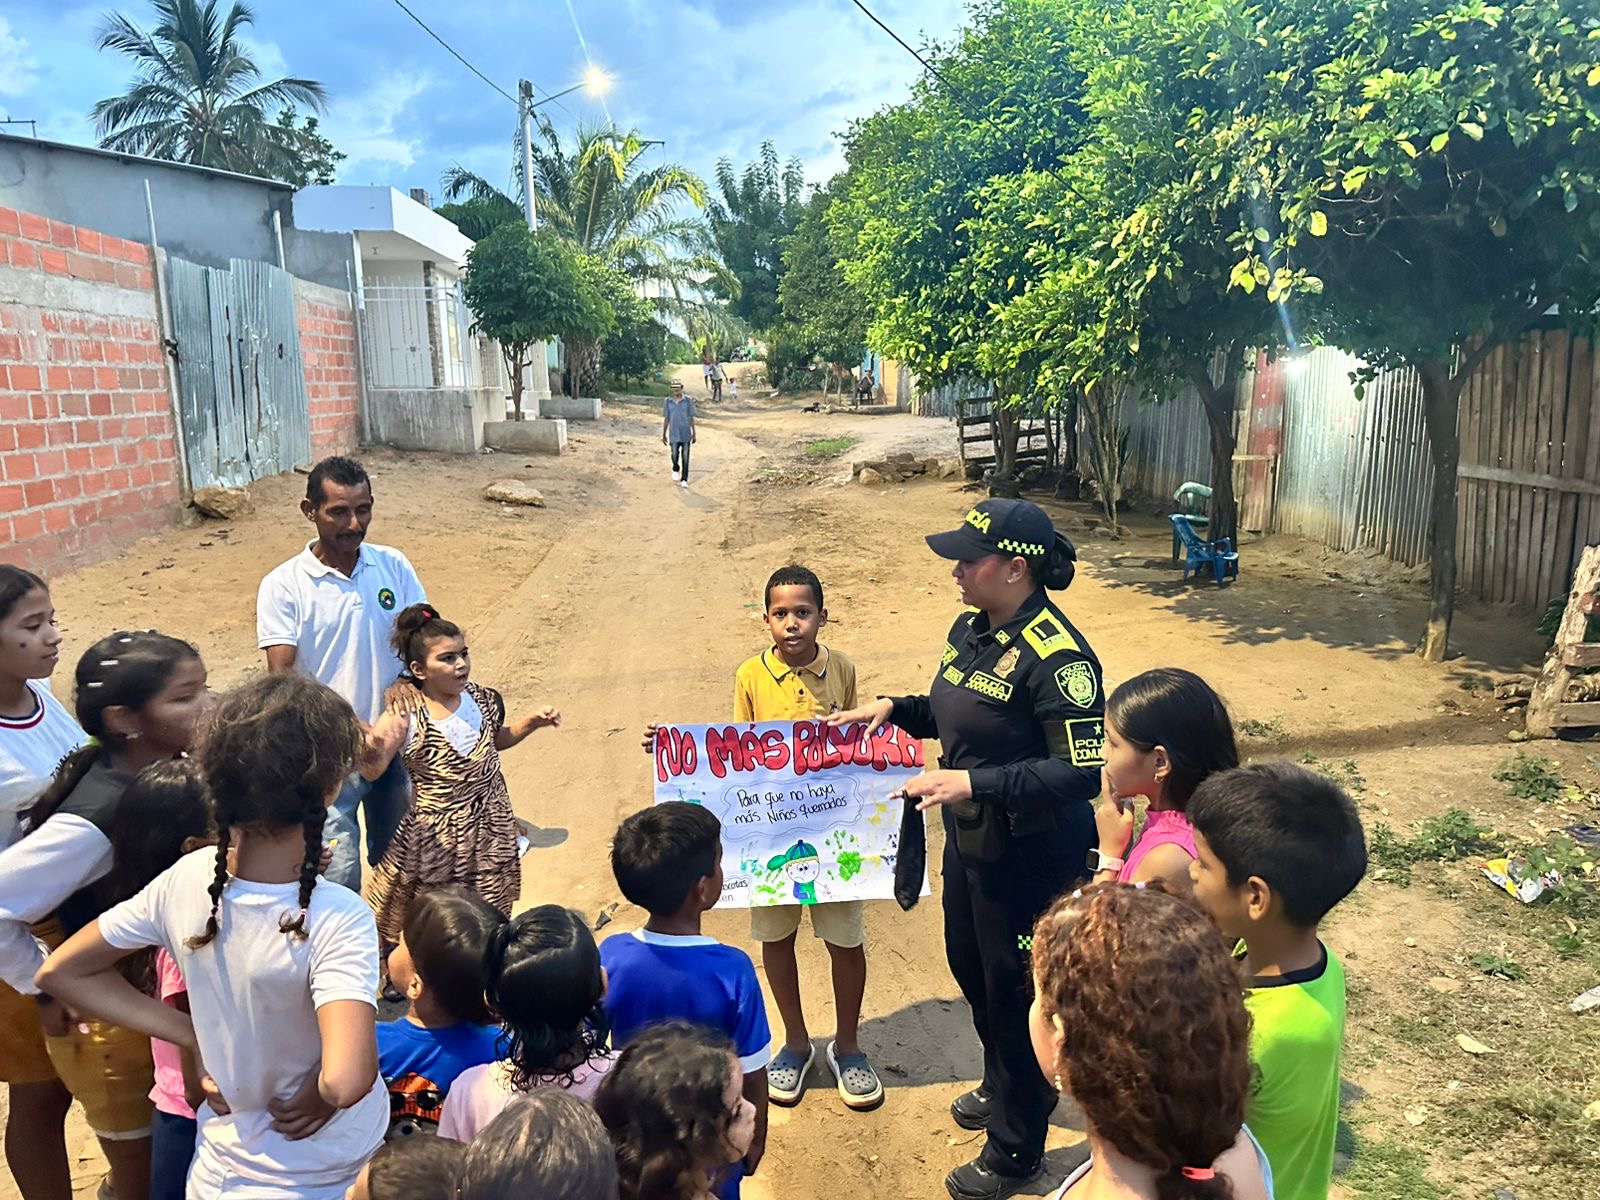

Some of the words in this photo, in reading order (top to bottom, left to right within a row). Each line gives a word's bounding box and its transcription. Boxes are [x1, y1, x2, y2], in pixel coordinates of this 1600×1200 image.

[656, 726, 698, 782] NO
[706, 723, 790, 778] MÁS
[735, 810, 760, 823] más
[767, 809, 797, 824] Niños
[800, 796, 847, 819] quemados
[737, 789, 760, 807] Para
[764, 792, 784, 809] que
[790, 790, 804, 801] no
[807, 783, 835, 800] haya
